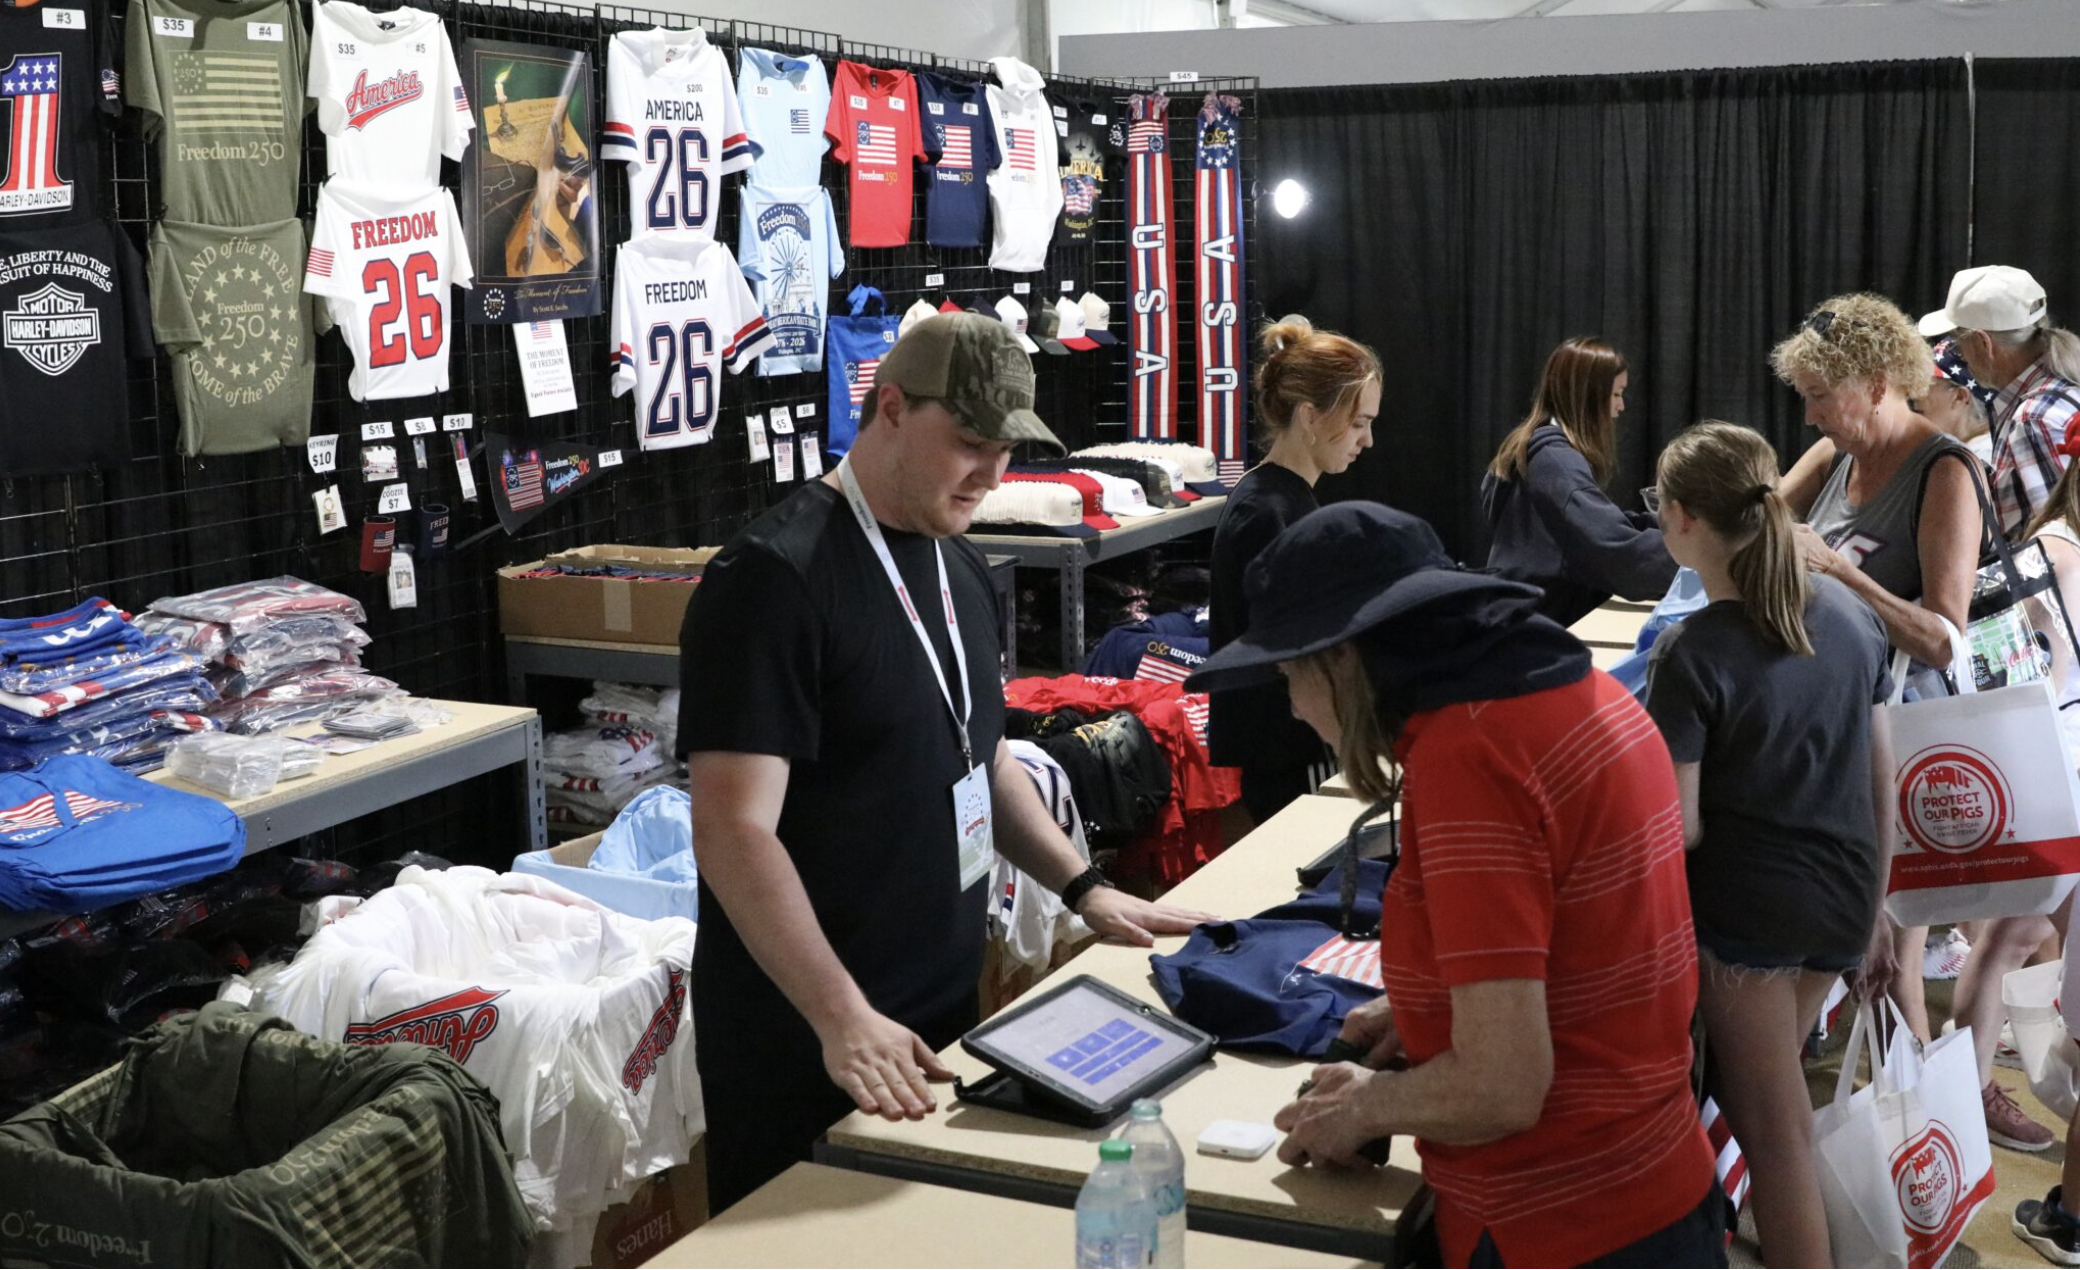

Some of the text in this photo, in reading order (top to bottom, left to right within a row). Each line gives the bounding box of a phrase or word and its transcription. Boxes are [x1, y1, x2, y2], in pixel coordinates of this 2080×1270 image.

[56, 12, 72, 25] #3
[163, 19, 185, 32] $35
[259, 26, 272, 37] #4
[338, 43, 355, 55] $35
[415, 43, 426, 54] #5
[179, 68, 197, 80] 250
[1176, 72, 1192, 80] $45
[345, 68, 424, 116] America
[687, 84, 703, 93] $200
[757, 86, 769, 96] $35
[645, 99, 704, 121] AMERICA
[178, 141, 285, 167] Freedom 250
[644, 126, 710, 231] 26
[858, 170, 898, 185] Freedom 250
[960, 172, 974, 185] 250
[0, 189, 69, 208] ARLEY-DAVIDSON
[351, 211, 439, 250] FREEDOM
[760, 210, 796, 236] Freedom
[9, 249, 64, 268] LIBERTY
[63, 251, 89, 267] AND
[89, 257, 111, 278] THE
[220, 236, 237, 259] of
[236, 236, 256, 256] the
[259, 243, 295, 294] FREE
[0, 266, 32, 285] SUIT
[33, 263, 51, 276] OF
[52, 263, 114, 293] HAPPINESS
[645, 279, 707, 304] FREEDOM
[30, 292, 75, 314] MOTOR
[216, 300, 265, 315] Freedom
[362, 250, 444, 370] 26
[11, 318, 92, 339] HARLEY-DAVIDSON
[219, 314, 265, 349] 250
[32, 342, 76, 367] CYCLES
[225, 387, 243, 408] of
[242, 387, 263, 405] the
[263, 334, 299, 396] BRAVE
[644, 317, 715, 439] 26
[369, 424, 385, 435] $15
[776, 418, 787, 429] $5
[312, 451, 331, 466] $10
[545, 458, 569, 470] Freedom
[603, 453, 616, 463] $15
[388, 499, 399, 510] $7
[1147, 641, 1170, 656] 250
[1921, 791, 1981, 809] PROTECT
[1924, 805, 1984, 821] OUR PIGS
[270, 1151, 327, 1185] 250
[1, 1210, 153, 1265] Freedom 250
[616, 1209, 673, 1260] Hanes
